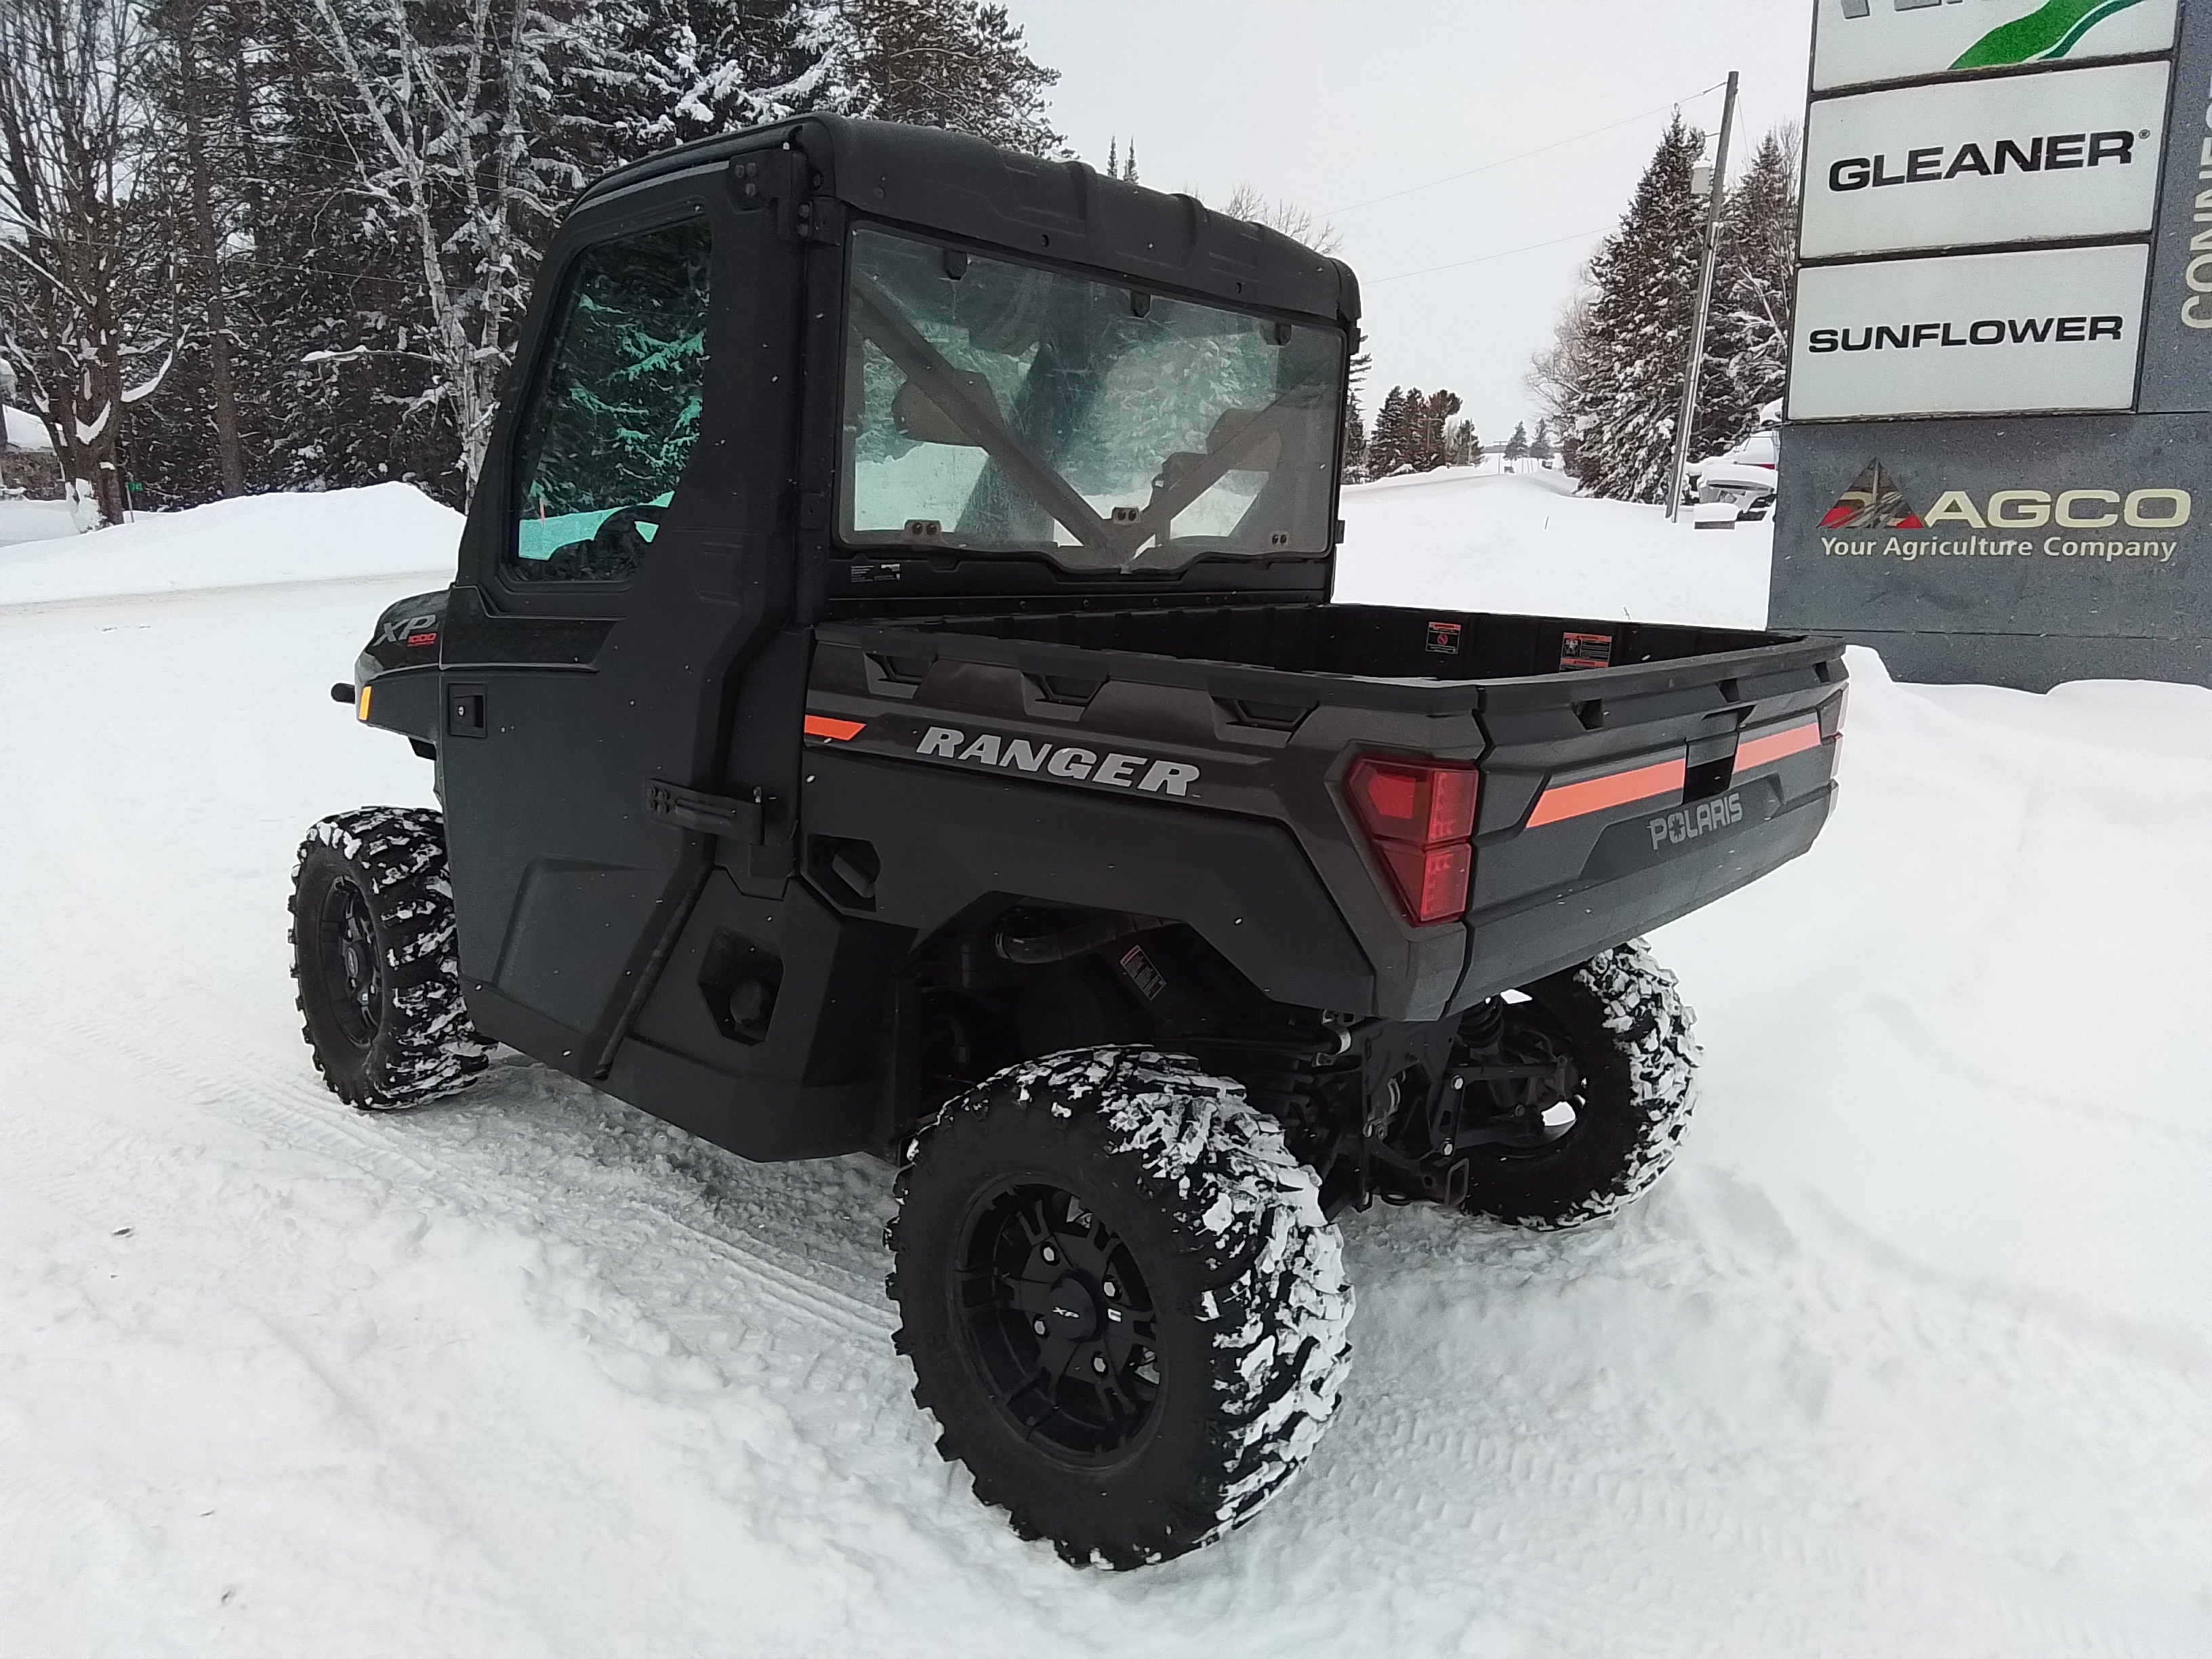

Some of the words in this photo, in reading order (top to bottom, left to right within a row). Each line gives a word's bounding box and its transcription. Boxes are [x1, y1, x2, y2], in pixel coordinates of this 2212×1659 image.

[1808, 316, 2124, 353] SUNFLOWER
[1924, 489, 2191, 529] AGCO
[1821, 536, 1877, 557] Your
[1883, 535, 2033, 560] Agriculture
[2043, 536, 2177, 562] Company
[371, 614, 436, 647] XP
[408, 632, 437, 644] 1000
[916, 726, 1201, 797] RANGER
[1649, 792, 1743, 851] POLARIS
